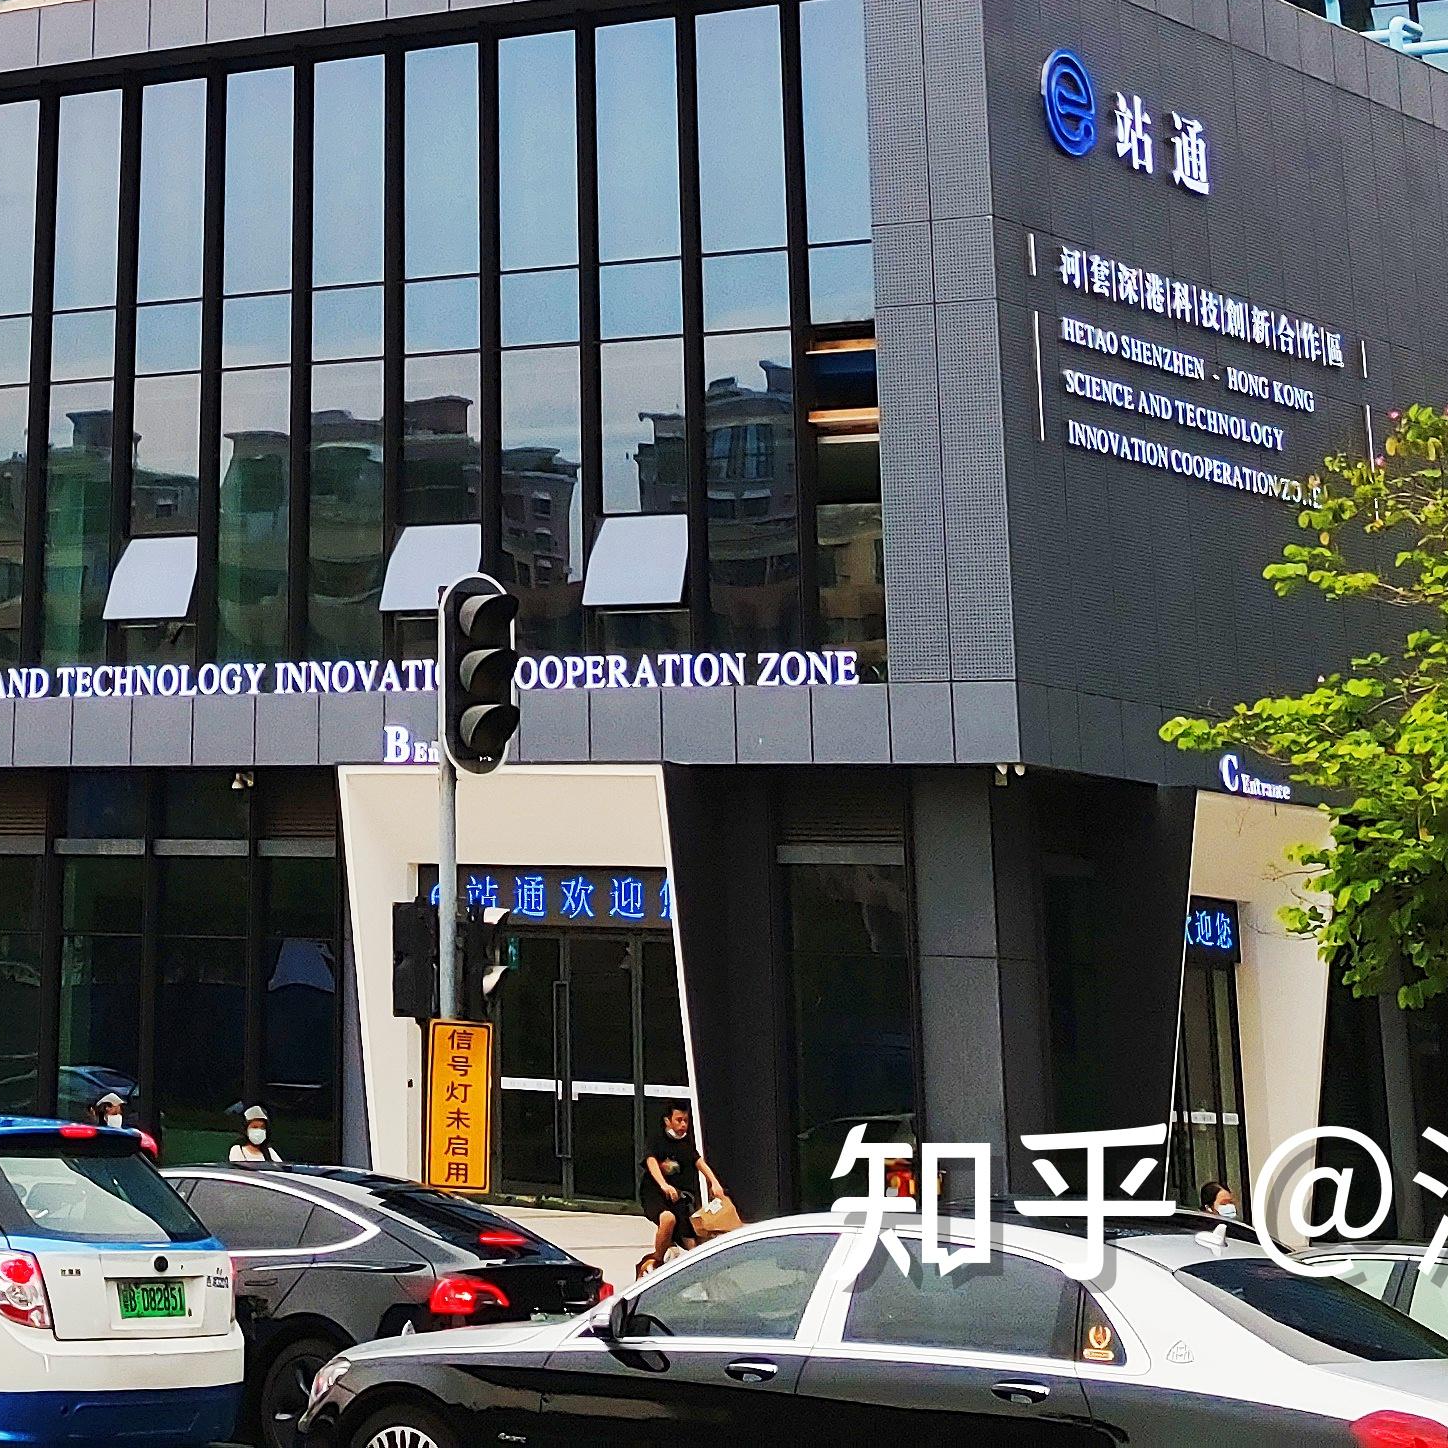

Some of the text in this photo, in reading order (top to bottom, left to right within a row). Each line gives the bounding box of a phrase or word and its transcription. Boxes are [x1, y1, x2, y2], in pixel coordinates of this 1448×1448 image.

[1114, 92, 1210, 195] 站通
[1061, 316, 1118, 355] HETAO
[1121, 335, 1205, 381] SHENZHEN
[1226, 366, 1269, 399] HONG
[1272, 380, 1315, 413] KONG
[1065, 369, 1284, 451] SCIENCE AND TECHNOLOGY
[1068, 419, 1323, 509] INNOVATION COOPERATION ZOE
[56, 662, 267, 699] TECHNOLOGY
[274, 658, 439, 695] INNOVATI
[515, 652, 747, 691] OOPERATION
[757, 650, 860, 687] ZONE
[1220, 754, 1291, 800] C Entrance
[444, 1029, 474, 1184] 信号灯未启用
